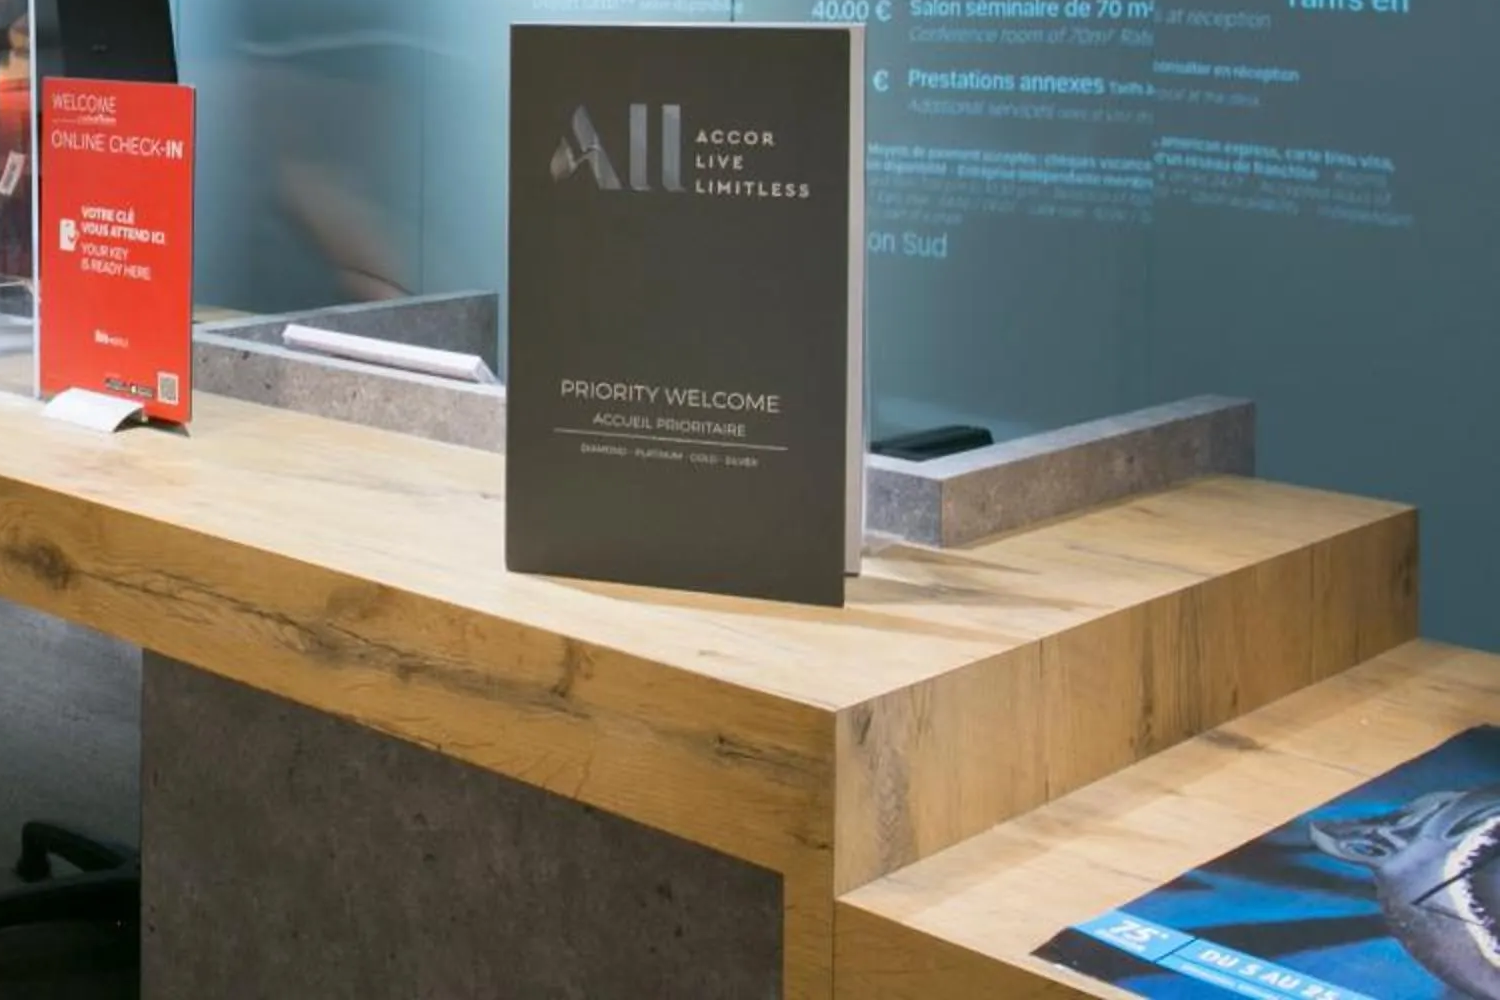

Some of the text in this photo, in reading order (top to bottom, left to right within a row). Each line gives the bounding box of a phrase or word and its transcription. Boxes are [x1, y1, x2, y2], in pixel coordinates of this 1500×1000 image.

[872, 68, 890, 92] €
[907, 67, 1016, 93] Prestations
[1019, 73, 1106, 96] annexes
[52, 93, 117, 113] WELCOME
[51, 130, 184, 159] ONLINE CHECK-IN
[694, 129, 775, 148] ACCOR
[694, 153, 744, 171] LIVE
[694, 179, 811, 199] LIMITLESS
[81, 221, 109, 237] VOUS
[868, 231, 948, 260] on Sud
[560, 378, 782, 414] PRIORITY WELCOME
[592, 412, 746, 438] ACCUEIL PRIORITAIRE
[1199, 949, 1239, 969] DU
[1259, 971, 1301, 990] AU
